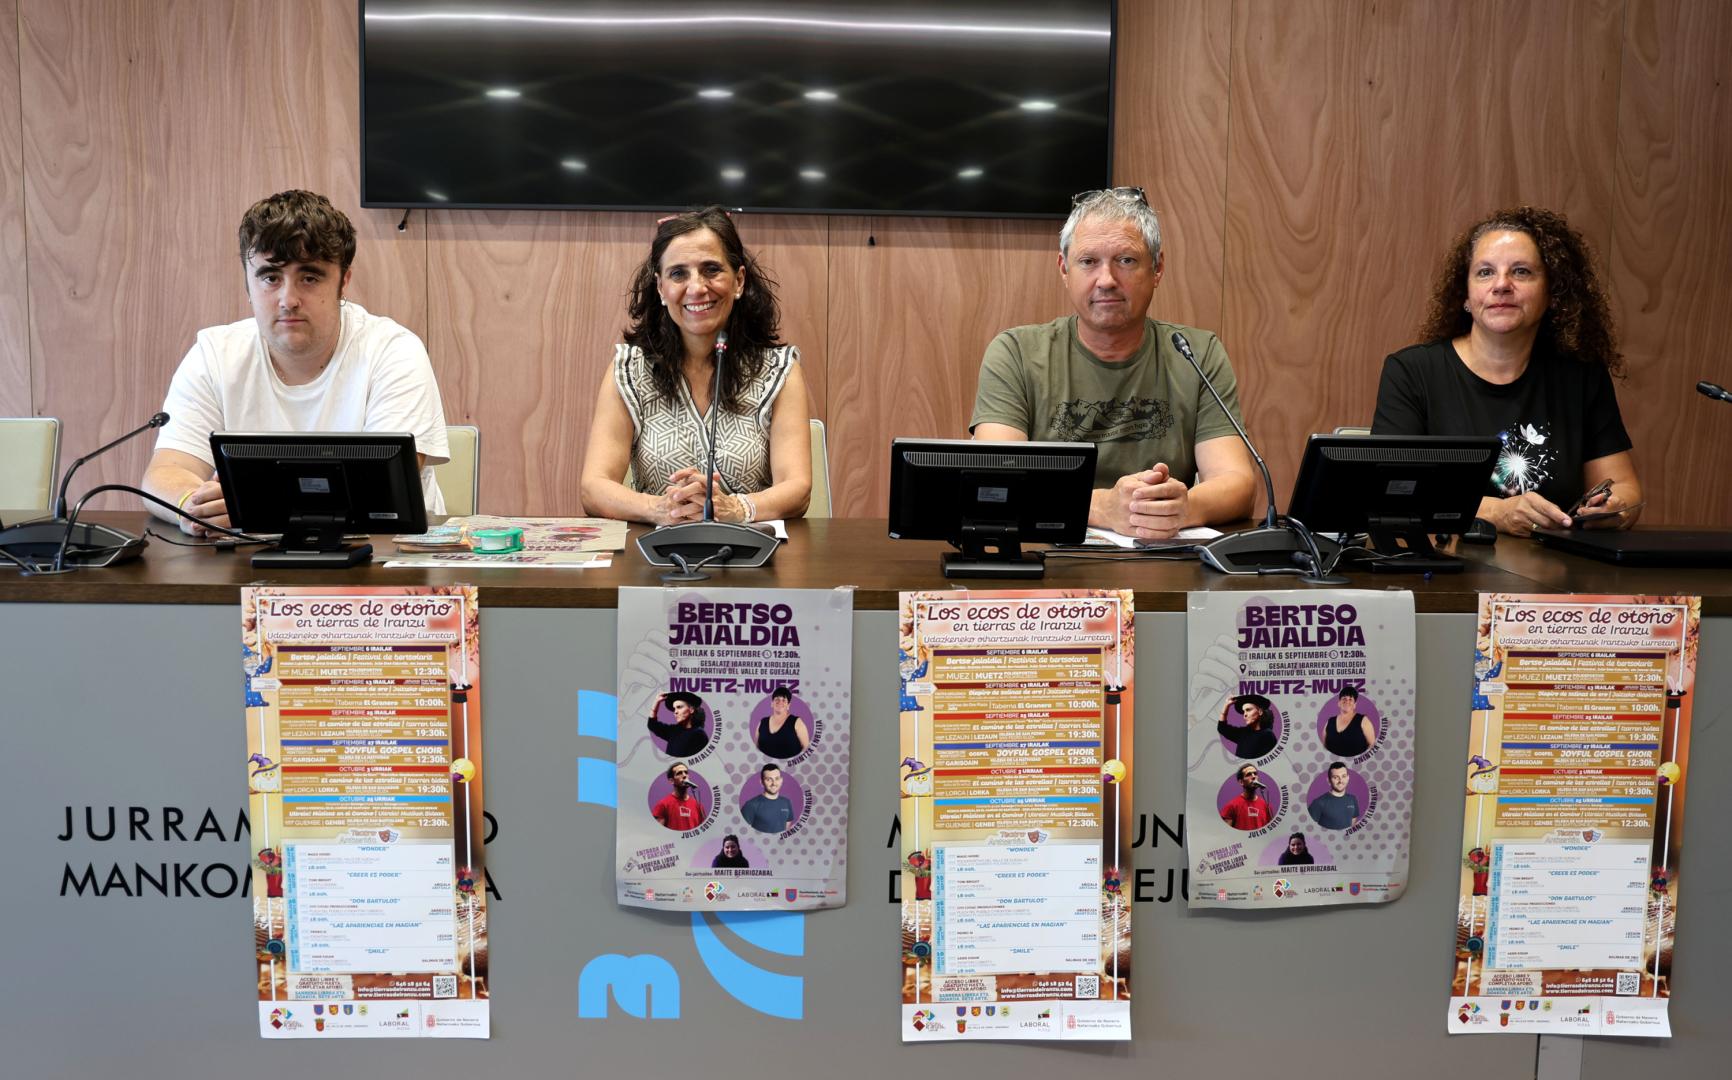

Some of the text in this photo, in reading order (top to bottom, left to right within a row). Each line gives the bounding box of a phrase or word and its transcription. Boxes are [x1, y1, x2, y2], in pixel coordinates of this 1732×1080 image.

[270, 599, 452, 616] Los ecos de otoño
[678, 603, 792, 624] BERTSO
[928, 603, 1108, 621] Los ecos de otoño
[1246, 604, 1357, 627] BERTSO
[1505, 606, 1675, 624] Los ecos de otoño
[296, 618, 425, 628] en tierras de Iranzu
[954, 621, 1082, 632] en tierras de Iranzu
[1547, 625, 1586, 634] tierras
[1592, 625, 1606, 634] de
[1611, 626, 1649, 635] Iranzu
[268, 632, 318, 640] Udazkeneko
[417, 632, 456, 640] Lurretan
[669, 625, 800, 646] JAIALDIA
[1238, 626, 1365, 648] JAIALDIA
[924, 636, 975, 644] Udazkeneko
[1500, 638, 1548, 646] Udazkeneko
[717, 650, 760, 658] SEPTIEMBRE
[414, 668, 446, 676] 12:30h.
[1068, 670, 1100, 678] 12:30h.
[1634, 674, 1663, 682] 12:30h.
[415, 699, 446, 707] 10:00h.
[416, 729, 447, 737] 19:30h.
[1068, 731, 1099, 739] 19:30h.
[688, 710, 722, 766] MAIALEN LUJANBIO
[1257, 712, 1290, 767] MAIALEN LUJANBIO
[344, 746, 378, 754] JOYFUL
[380, 746, 413, 754] GOSPEL
[996, 749, 1029, 757] JOYFUL
[1068, 748, 1094, 756] CHOIR
[1560, 750, 1652, 758] JOYFUL GOSPEL CHOIR
[416, 755, 448, 763] 12:30h.
[1069, 757, 1099, 765] 12:30h.
[1627, 759, 1656, 767] 12:30h.
[417, 785, 448, 793] 19:30h.
[1068, 786, 1099, 794] 19:30h.
[1625, 787, 1653, 795] 19:30h.
[418, 819, 449, 827] 12:30h.
[1068, 819, 1099, 827] 12:30h.
[1345, 818, 1368, 836] JOANES
[1622, 819, 1650, 827] 12:30h.
[681, 830, 700, 839] JULIO
[702, 818, 714, 832] SOTO
[780, 821, 802, 840] JOANES
[1248, 829, 1266, 838] JULIO
[1268, 818, 1281, 832] SOTO
